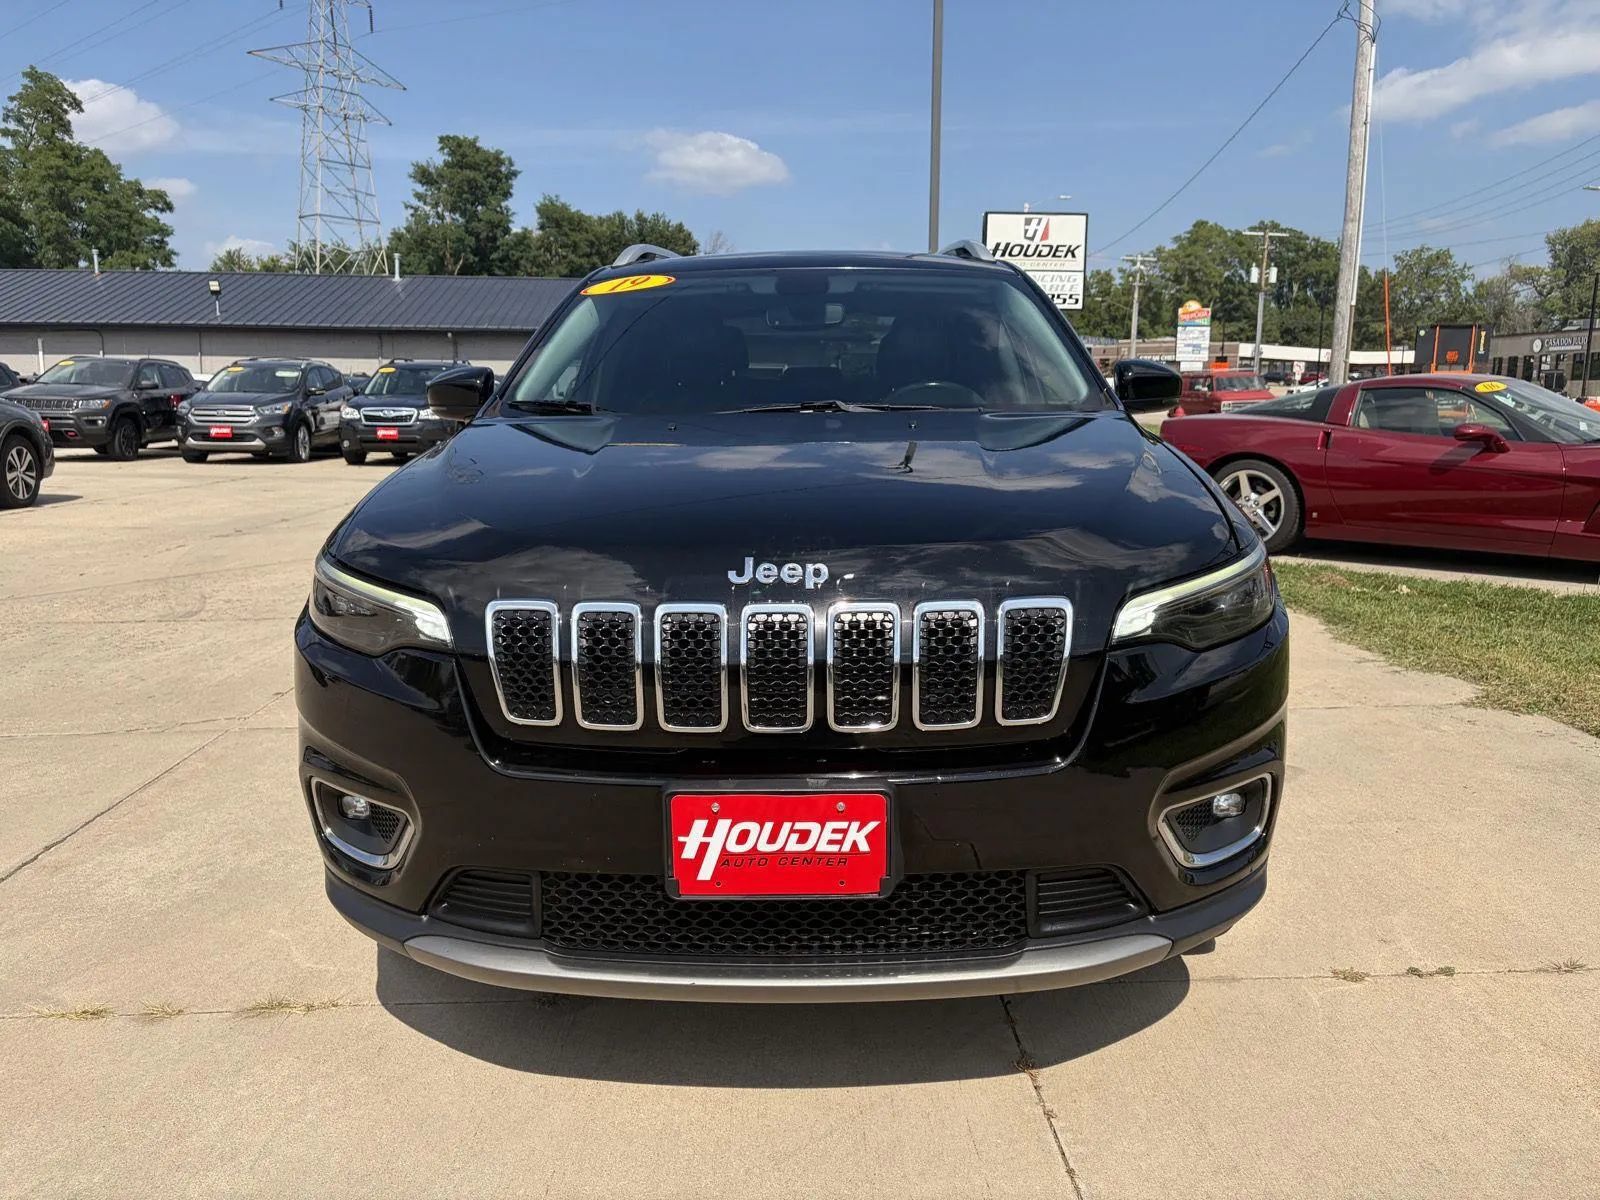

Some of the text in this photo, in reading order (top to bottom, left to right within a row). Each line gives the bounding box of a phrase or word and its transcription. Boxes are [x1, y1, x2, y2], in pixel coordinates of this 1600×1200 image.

[991, 242, 1082, 259] HOUDEK
[608, 276, 651, 291] 19
[1033, 274, 1078, 283] NCING
[727, 556, 830, 590] Jeep
[678, 818, 881, 881] HOUDEK
[719, 856, 849, 868] AUTO CENTER
